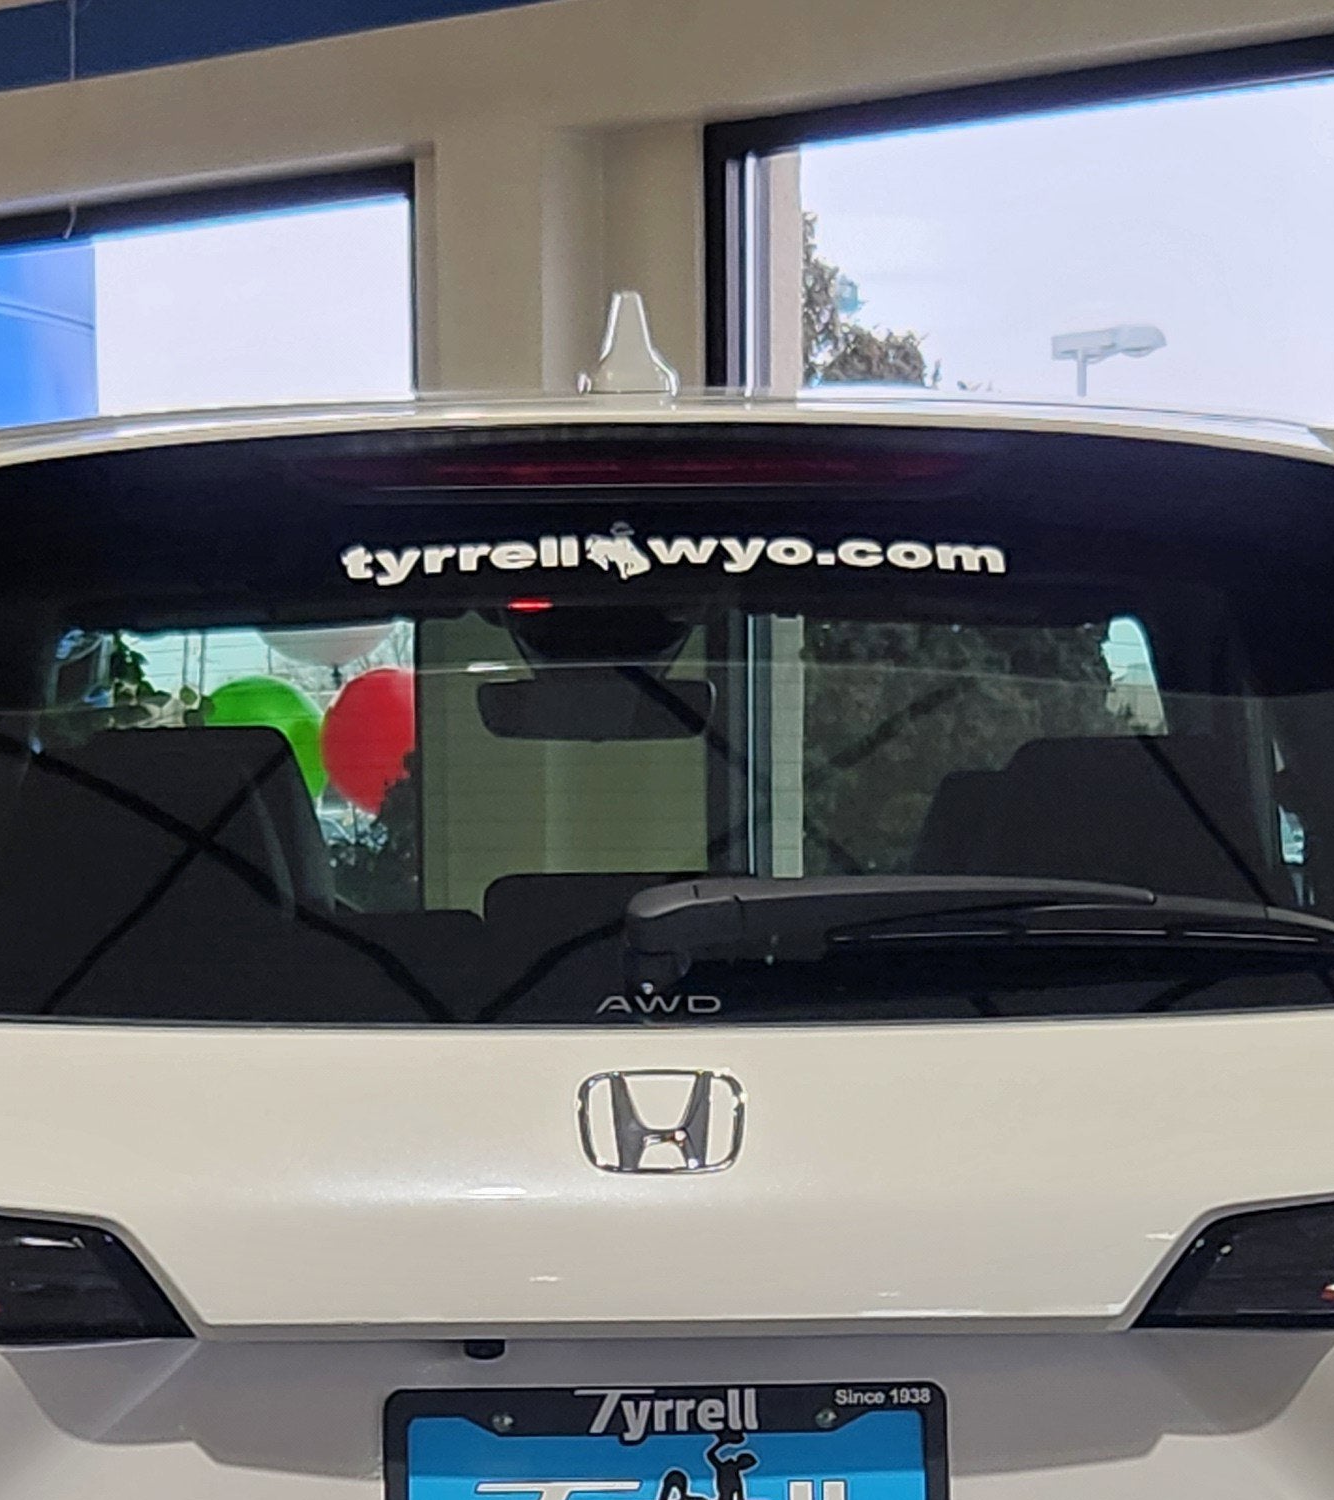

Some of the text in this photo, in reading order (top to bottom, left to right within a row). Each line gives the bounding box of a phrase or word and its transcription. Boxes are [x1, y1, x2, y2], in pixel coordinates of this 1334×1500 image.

[596, 995, 721, 1014] AWD
[835, 1387, 931, 1406] Since 1938
[574, 1387, 759, 1441] Tyrrell
